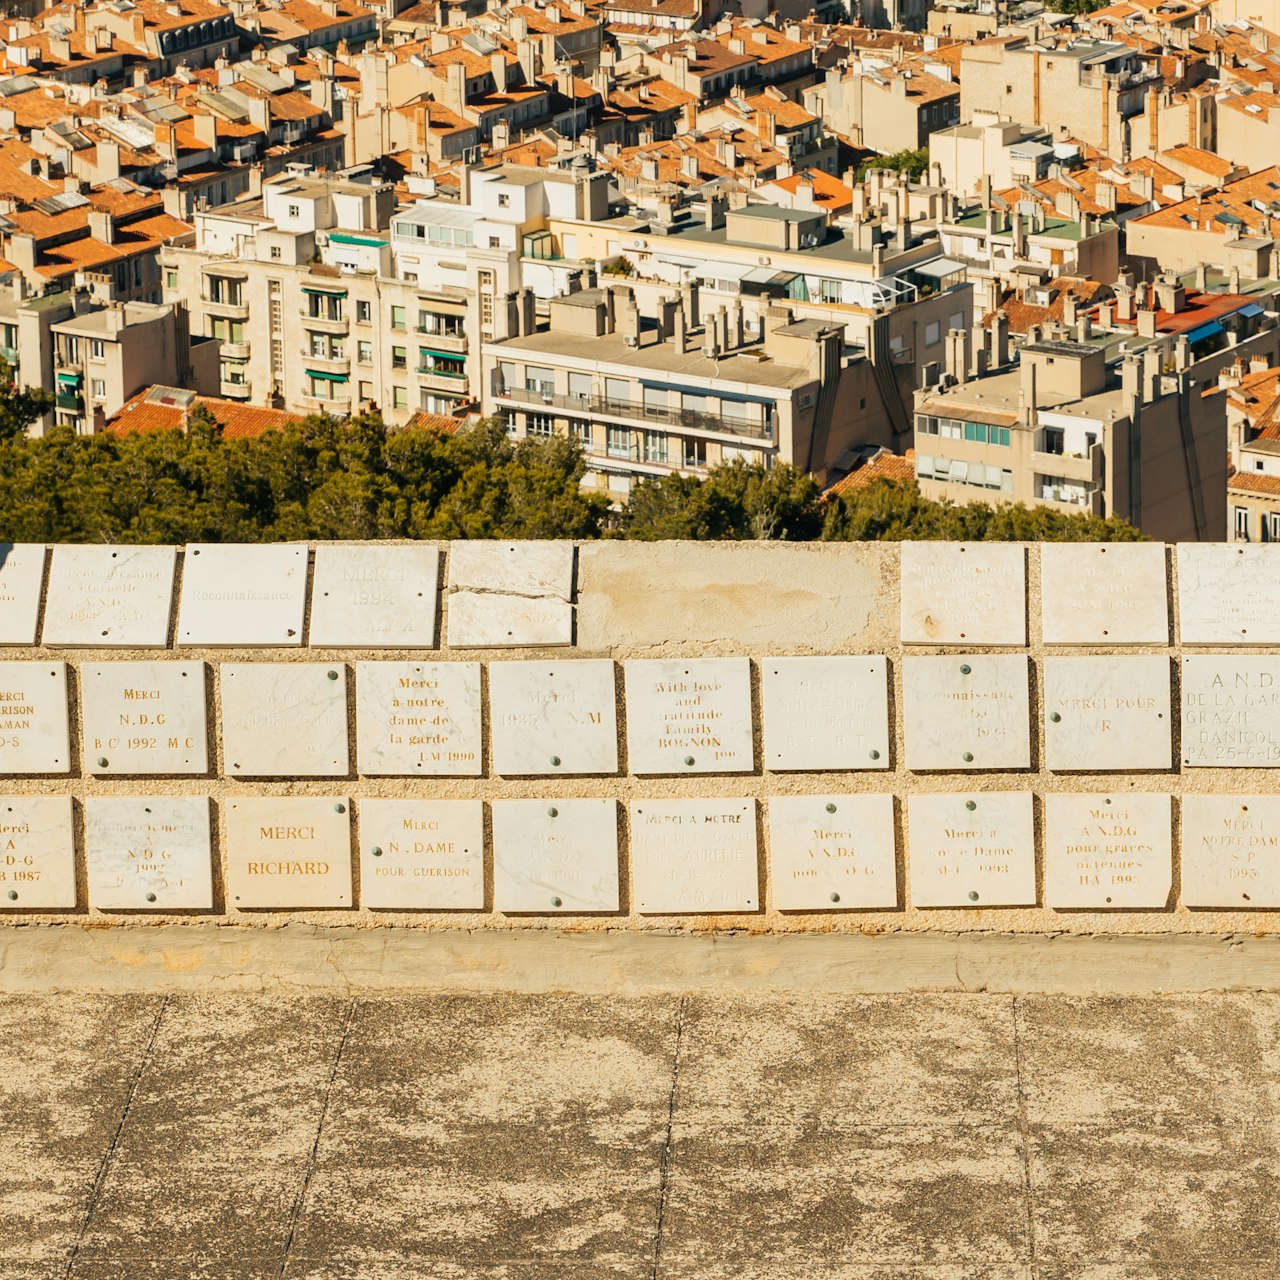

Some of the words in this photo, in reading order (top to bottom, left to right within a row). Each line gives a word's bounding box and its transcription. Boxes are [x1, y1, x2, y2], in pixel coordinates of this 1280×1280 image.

[398, 678, 439, 689] Merci
[403, 819, 439, 830] MERCI
[259, 827, 316, 840] MERCI
[6, 840, 16, 849] A
[414, 842, 455, 854] DAME
[247, 862, 329, 875] RICHARD
[376, 867, 405, 877] POUR
[413, 867, 470, 877] GUERISON
[13, 871, 41, 881] 1987
